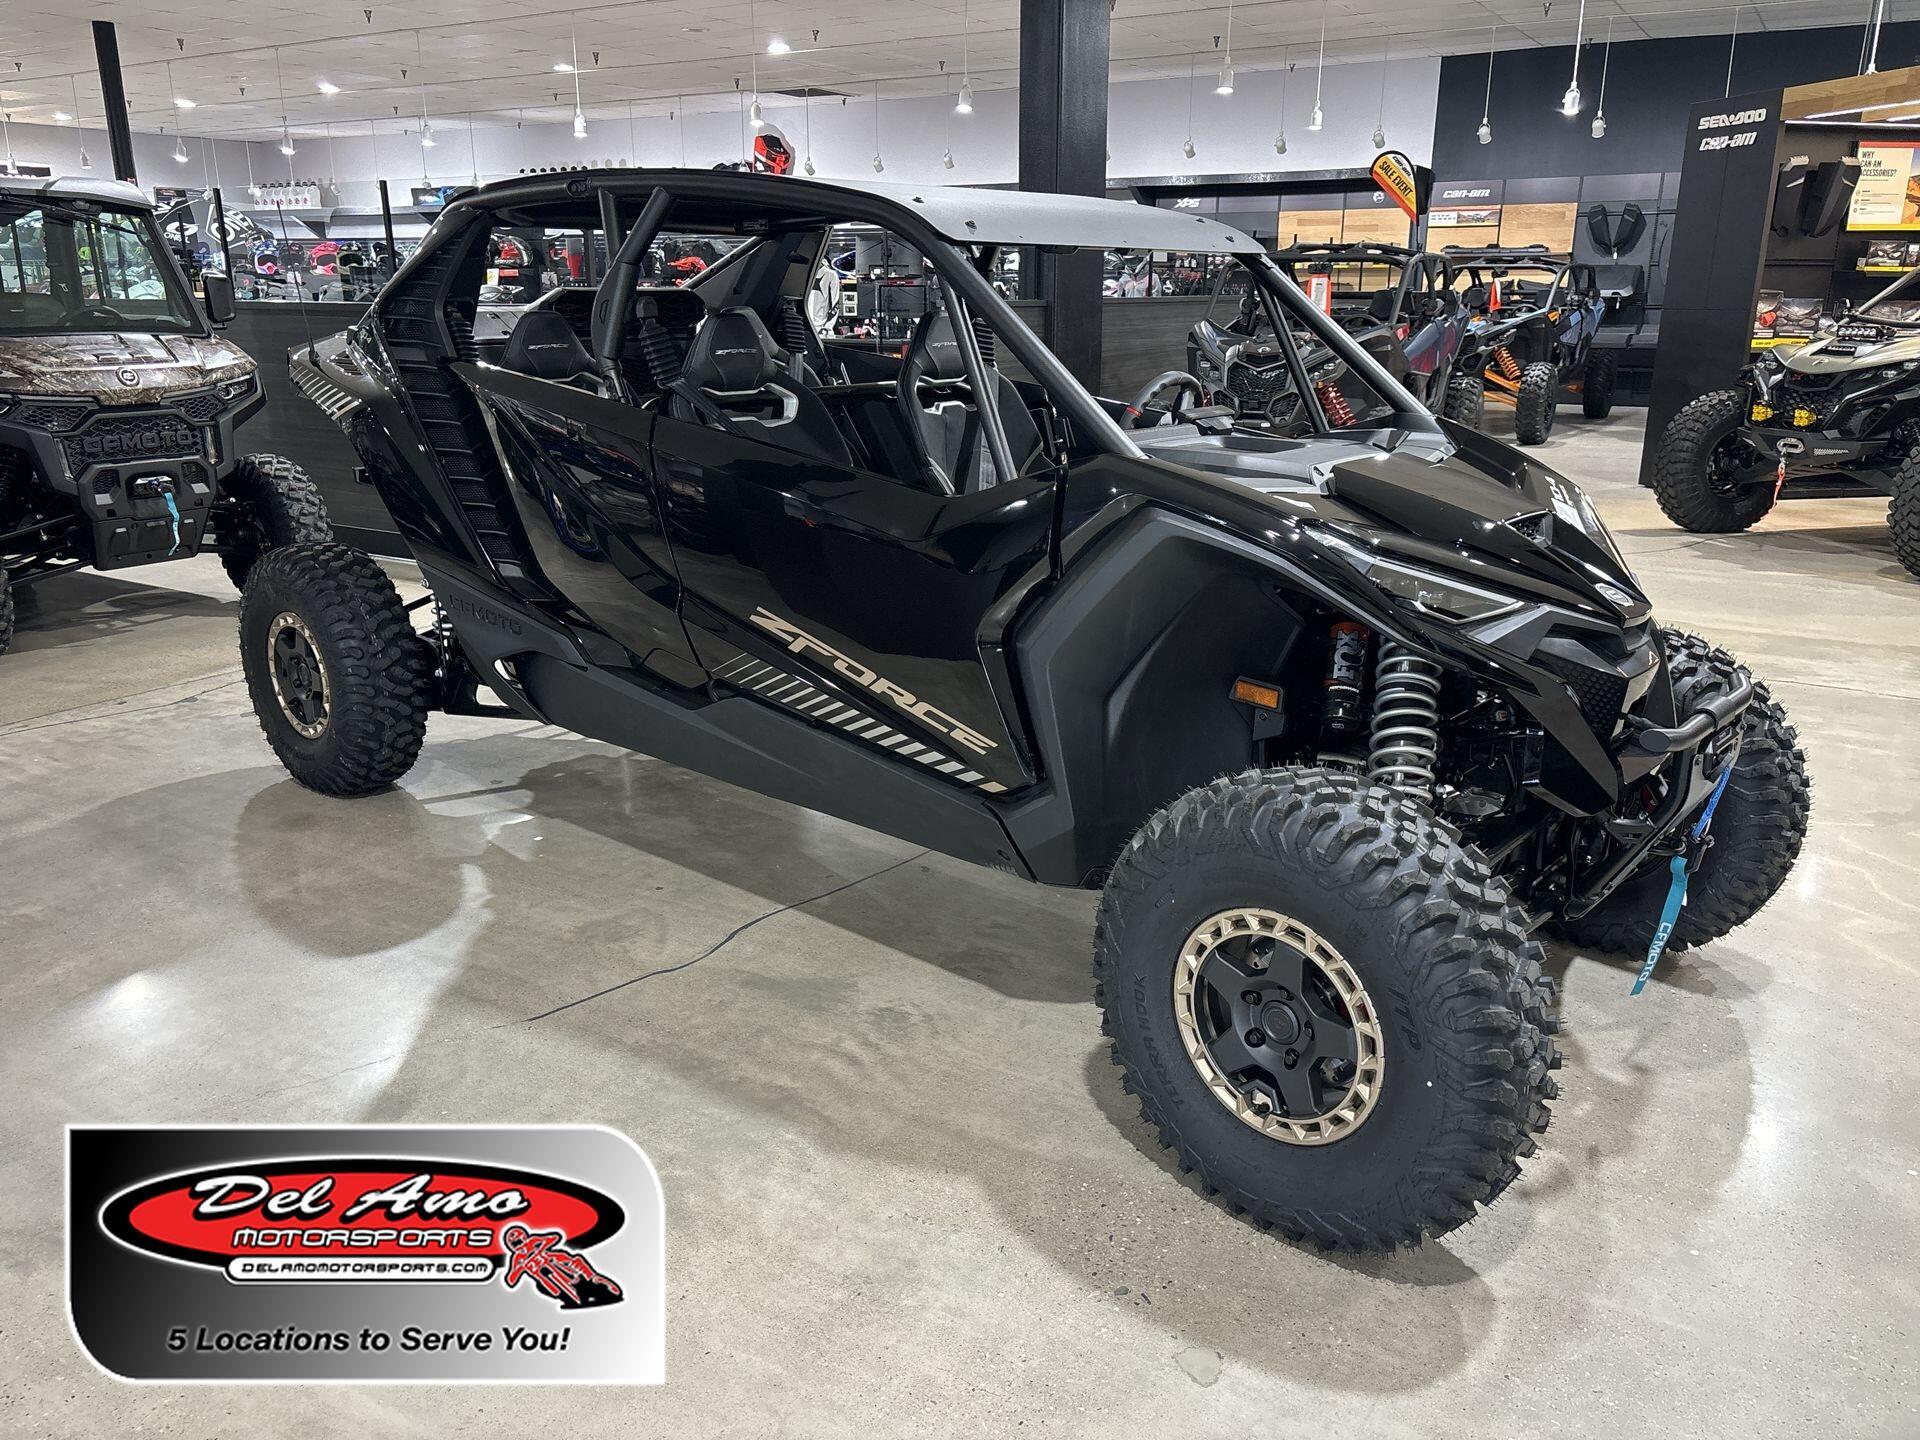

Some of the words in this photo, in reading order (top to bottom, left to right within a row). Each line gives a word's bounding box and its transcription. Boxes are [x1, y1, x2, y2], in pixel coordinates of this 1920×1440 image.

[1861, 151, 1876, 159] WHY
[1379, 161, 1395, 180] SALE
[1392, 175, 1413, 197] EVENT
[1174, 198, 1200, 208] XPS
[82, 430, 193, 453] CFMOTO
[450, 594, 522, 635] CFMOTO
[1332, 629, 1365, 681] FOX
[750, 606, 999, 755] ZFORCE
[1638, 921, 1672, 982] CFMOTO
[1134, 972, 1151, 1031] HOOK
[1143, 1036, 1184, 1110] TERRA
